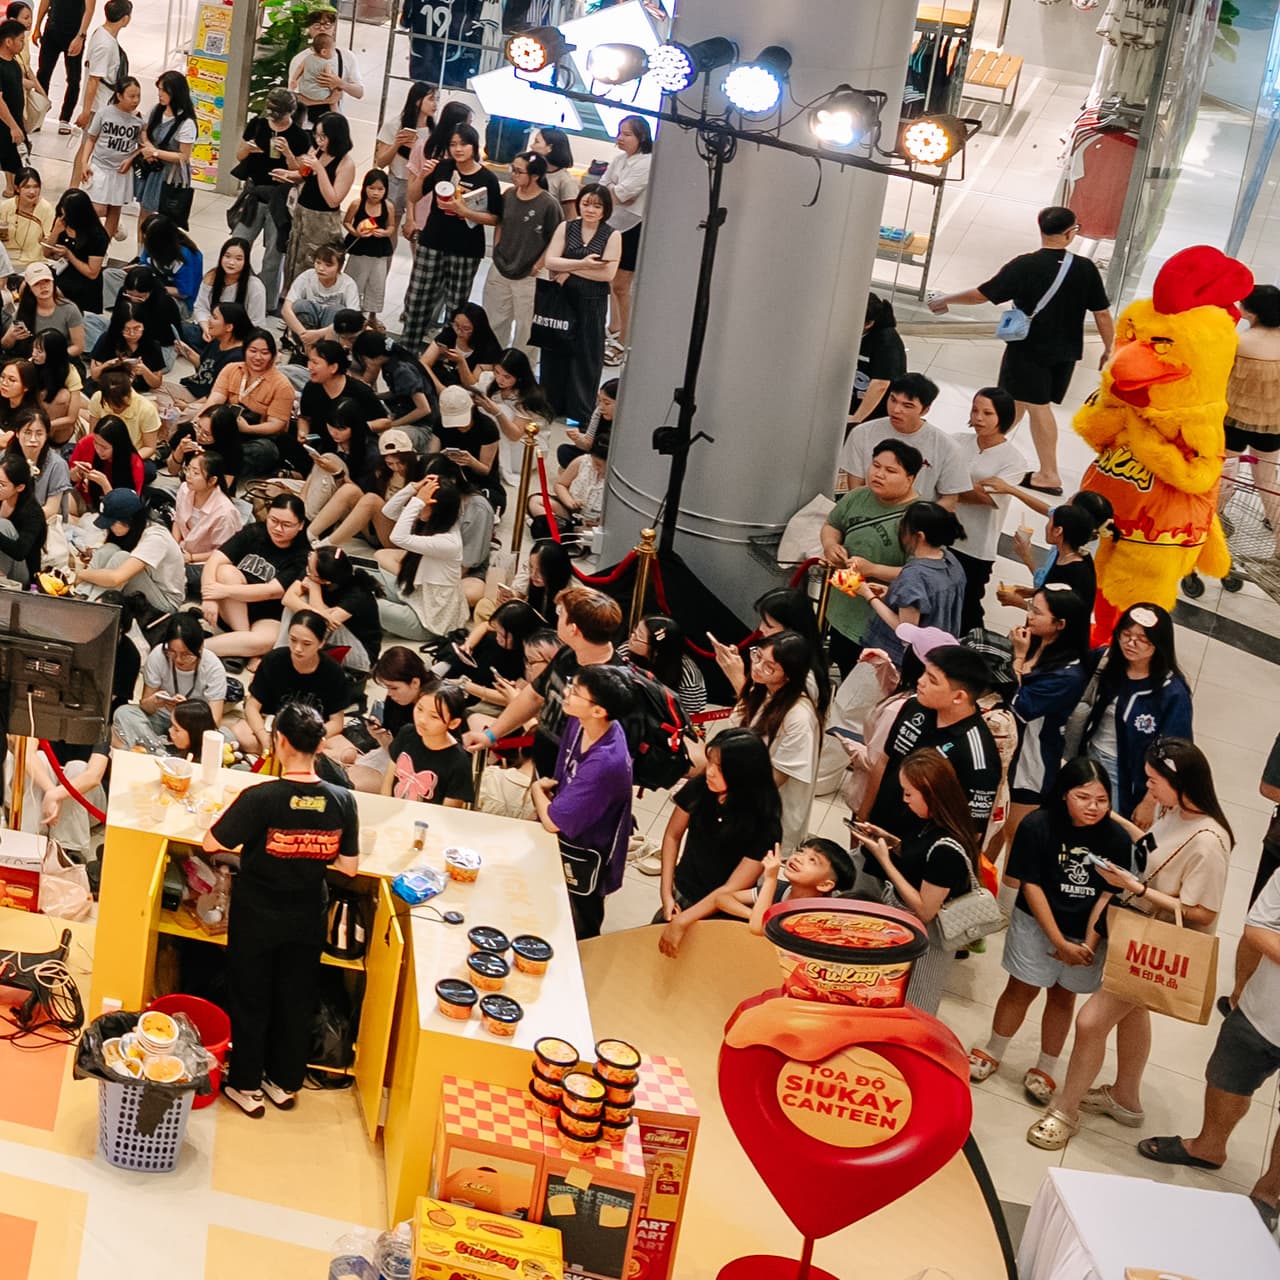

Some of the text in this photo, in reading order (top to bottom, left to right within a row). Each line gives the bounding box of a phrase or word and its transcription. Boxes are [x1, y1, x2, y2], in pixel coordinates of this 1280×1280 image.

[1060, 883, 1096, 897] PEANUTS
[806, 962, 880, 986] SiuKay
[1125, 939, 1190, 979] MUJI
[785, 1074, 904, 1115] SIUKAY
[856, 1073, 887, 1093] ĐỘ
[781, 1092, 899, 1131] CANTEEN
